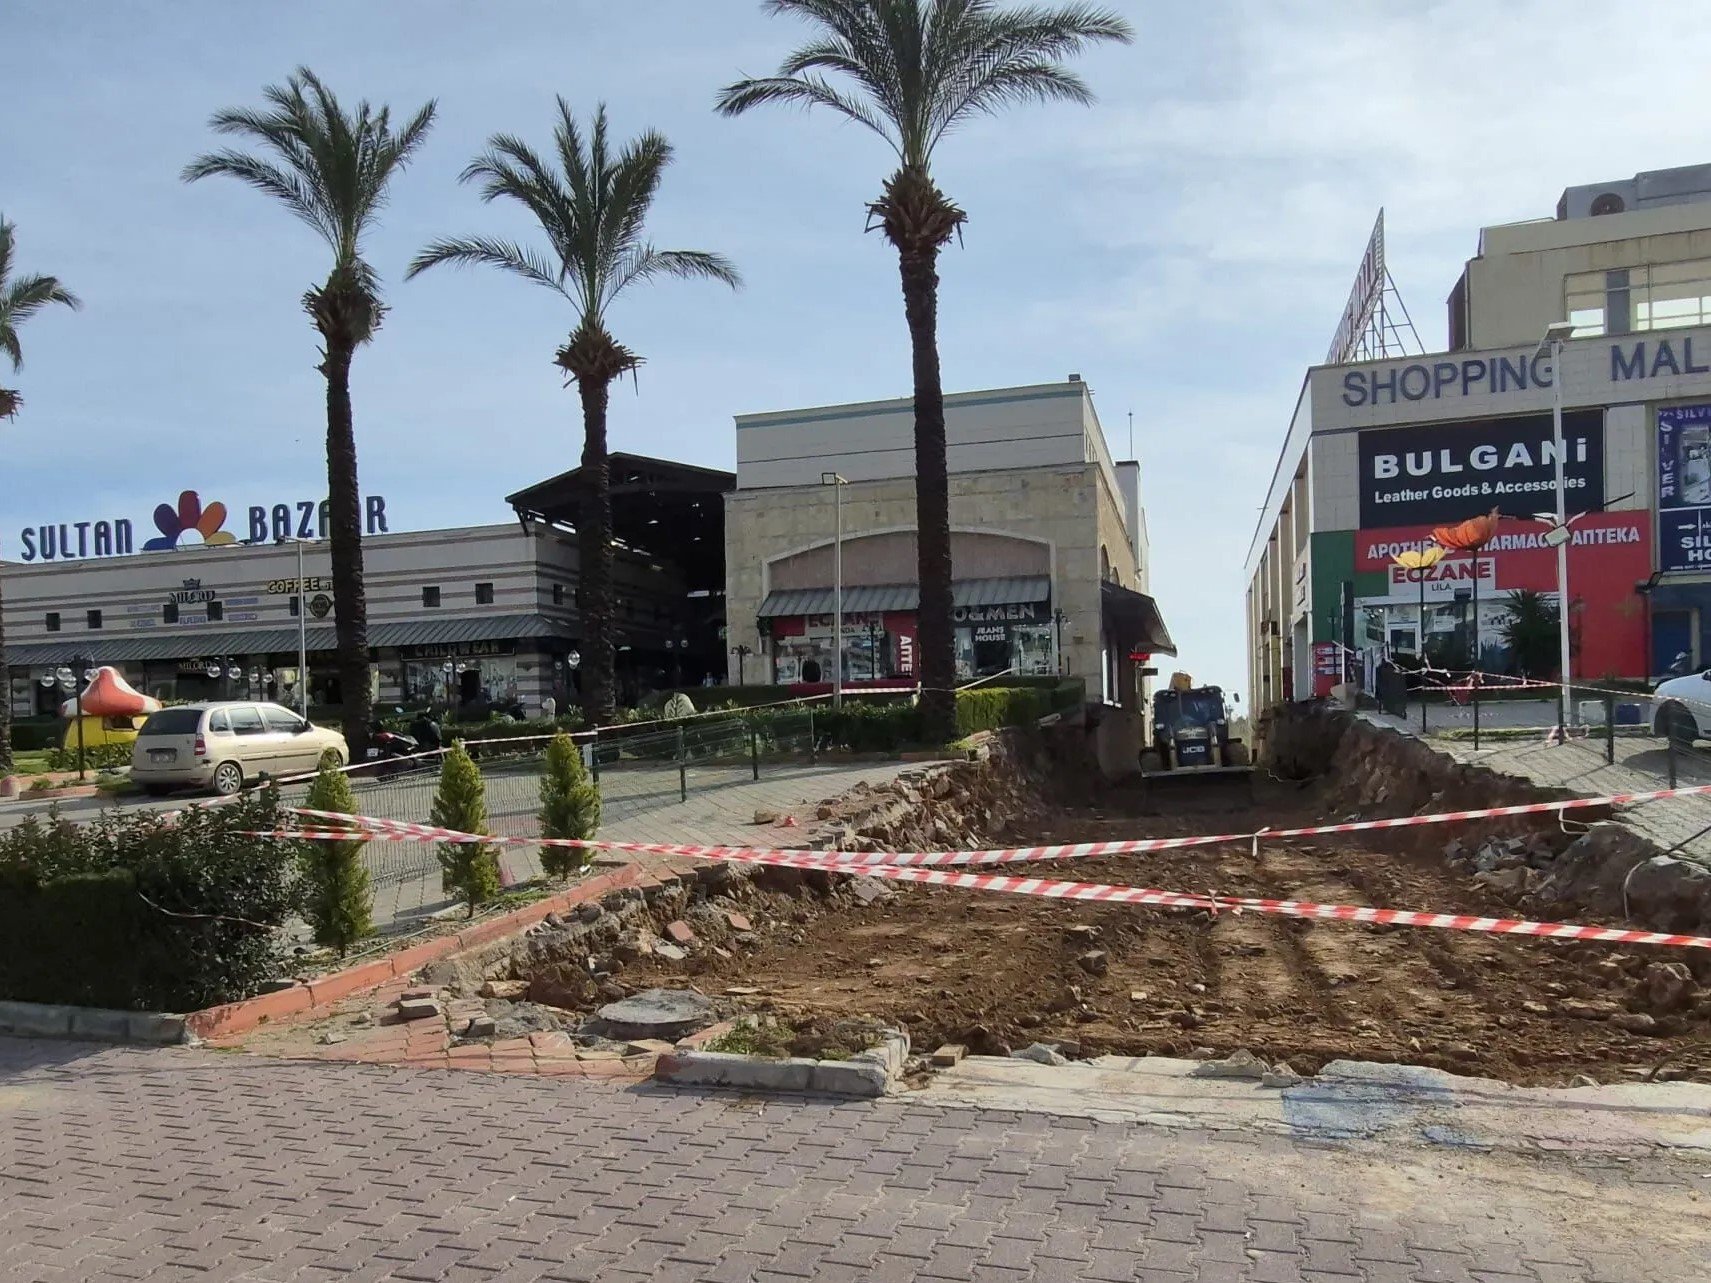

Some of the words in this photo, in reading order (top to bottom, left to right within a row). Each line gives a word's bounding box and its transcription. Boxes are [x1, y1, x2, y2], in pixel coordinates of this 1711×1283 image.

[1343, 354, 1554, 407] SHOPPING
[1375, 487, 1429, 504] Leather
[1432, 483, 1478, 499] Goods
[1481, 481, 1492, 494] &
[1495, 476, 1586, 494] Accessoies
[21, 519, 133, 561] SULTAN
[249, 495, 388, 543] BAZAR
[1571, 526, 1640, 546] АПТЕКА
[1393, 561, 1492, 584] ECZANE
[268, 578, 319, 594] COFFEE
